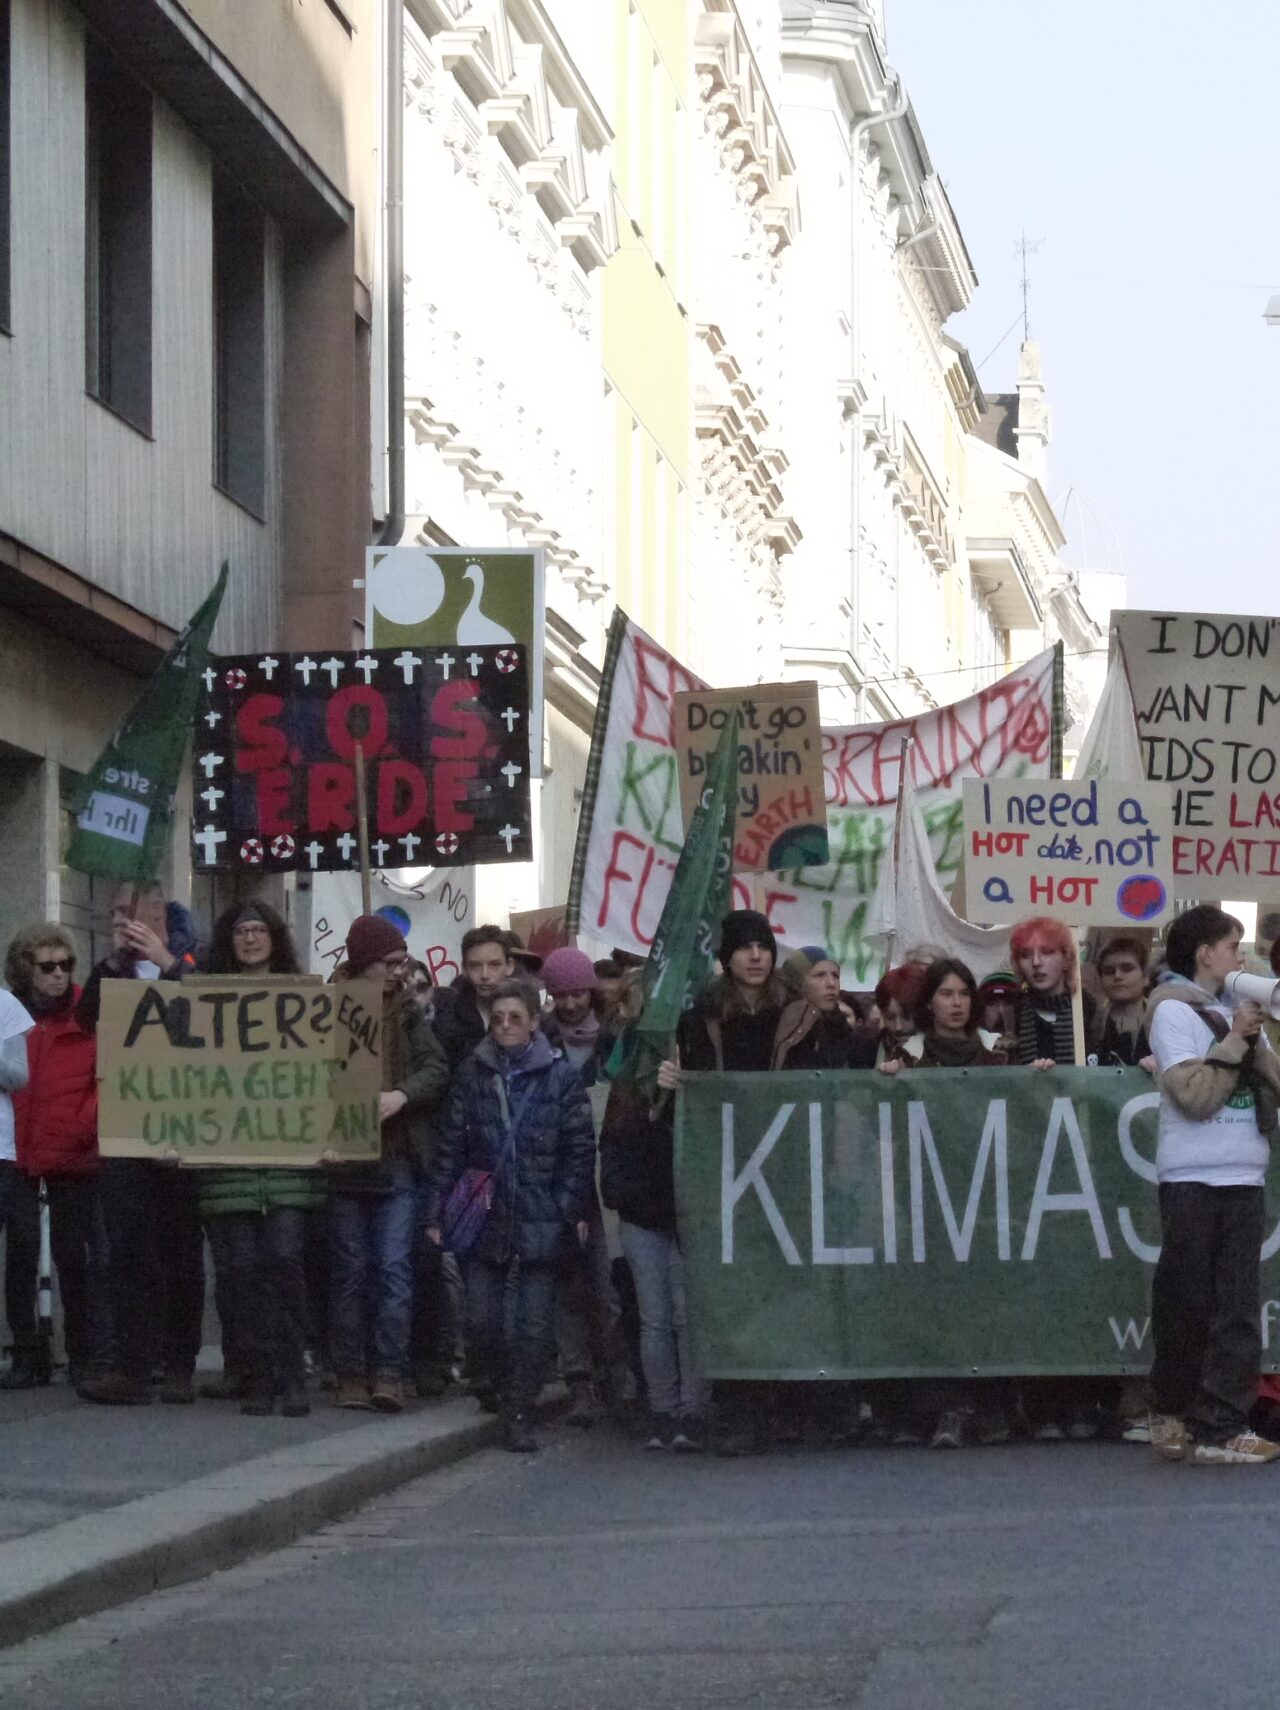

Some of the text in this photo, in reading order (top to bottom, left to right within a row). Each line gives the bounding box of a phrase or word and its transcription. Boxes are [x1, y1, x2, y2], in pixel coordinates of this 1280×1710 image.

[1147, 616, 1177, 654] I
[763, 704, 806, 739] go
[688, 738, 810, 776] bakin'
[1140, 736, 1215, 784] IDS
[1222, 741, 1276, 784] TO
[255, 761, 480, 836] ERDE
[983, 780, 1149, 827] I need a
[1172, 789, 1214, 826] HE
[734, 784, 814, 866] EARTH
[972, 830, 1030, 858] HOT
[1095, 829, 1161, 867] not
[983, 875, 1099, 906] a HOT
[123, 985, 333, 1053] ALTER?
[118, 1057, 342, 1102] KLIMA GEHT
[142, 1107, 222, 1147] UNS
[231, 1104, 317, 1144] ALLE
